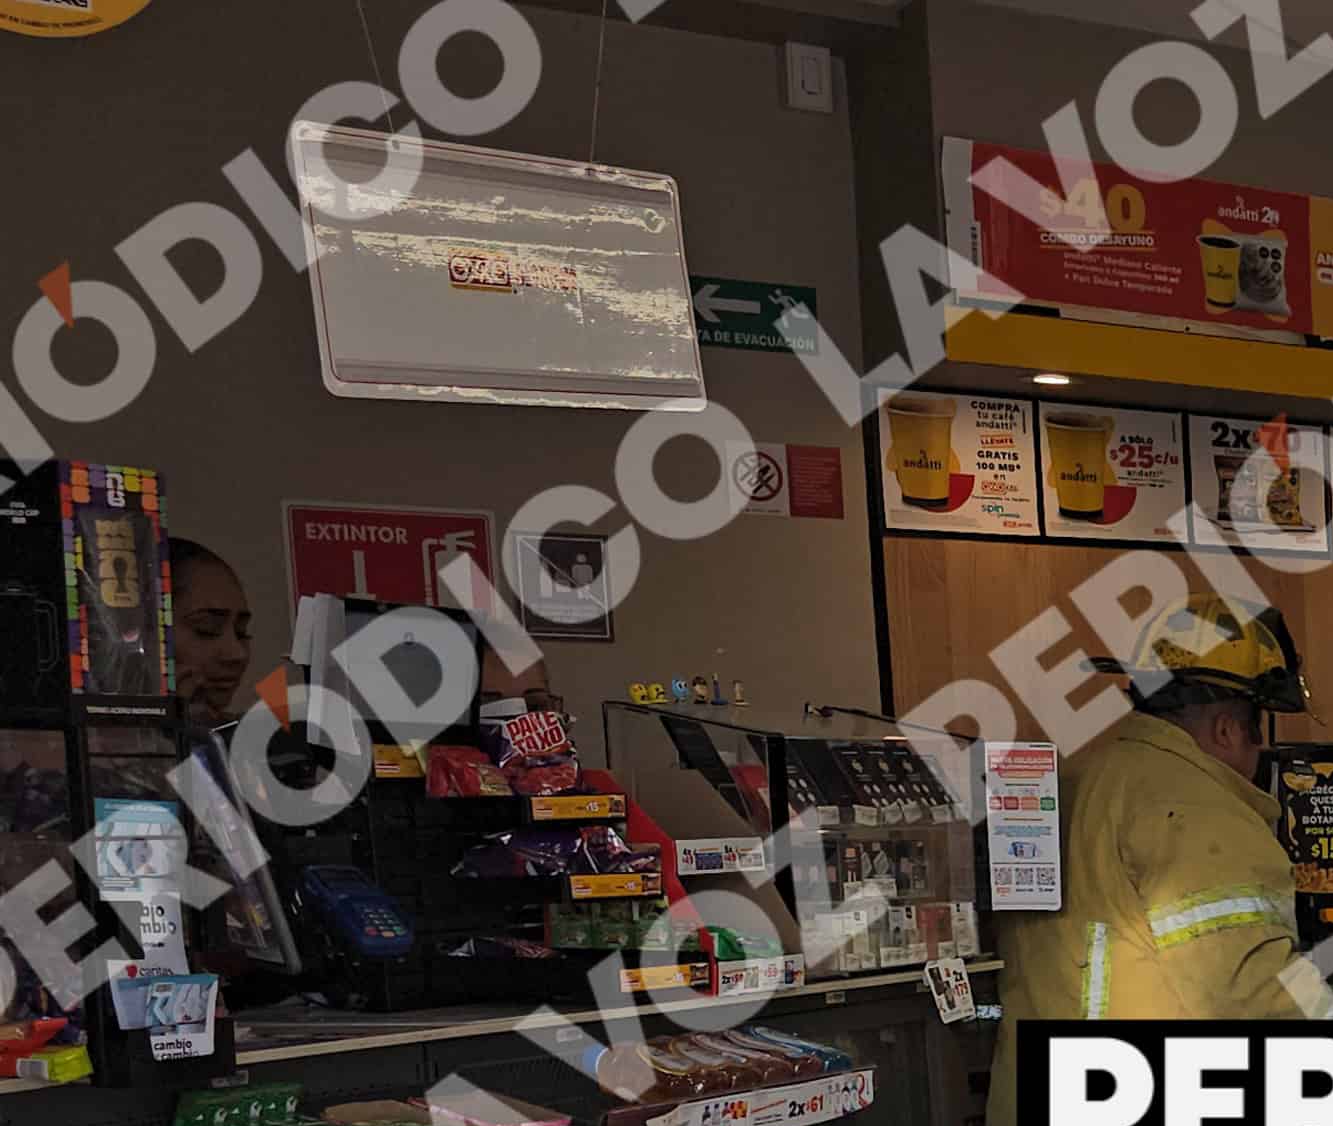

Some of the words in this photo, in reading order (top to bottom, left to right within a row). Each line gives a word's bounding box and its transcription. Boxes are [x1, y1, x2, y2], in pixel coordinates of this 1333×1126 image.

[714, 331, 731, 343] DE
[971, 400, 1020, 415] COMPRA
[976, 450, 1019, 462] GRATIS
[904, 458, 943, 471] andatti
[975, 462, 996, 471] 100
[1060, 469, 1097, 482] andatti
[305, 522, 408, 545] EXTINTOR
